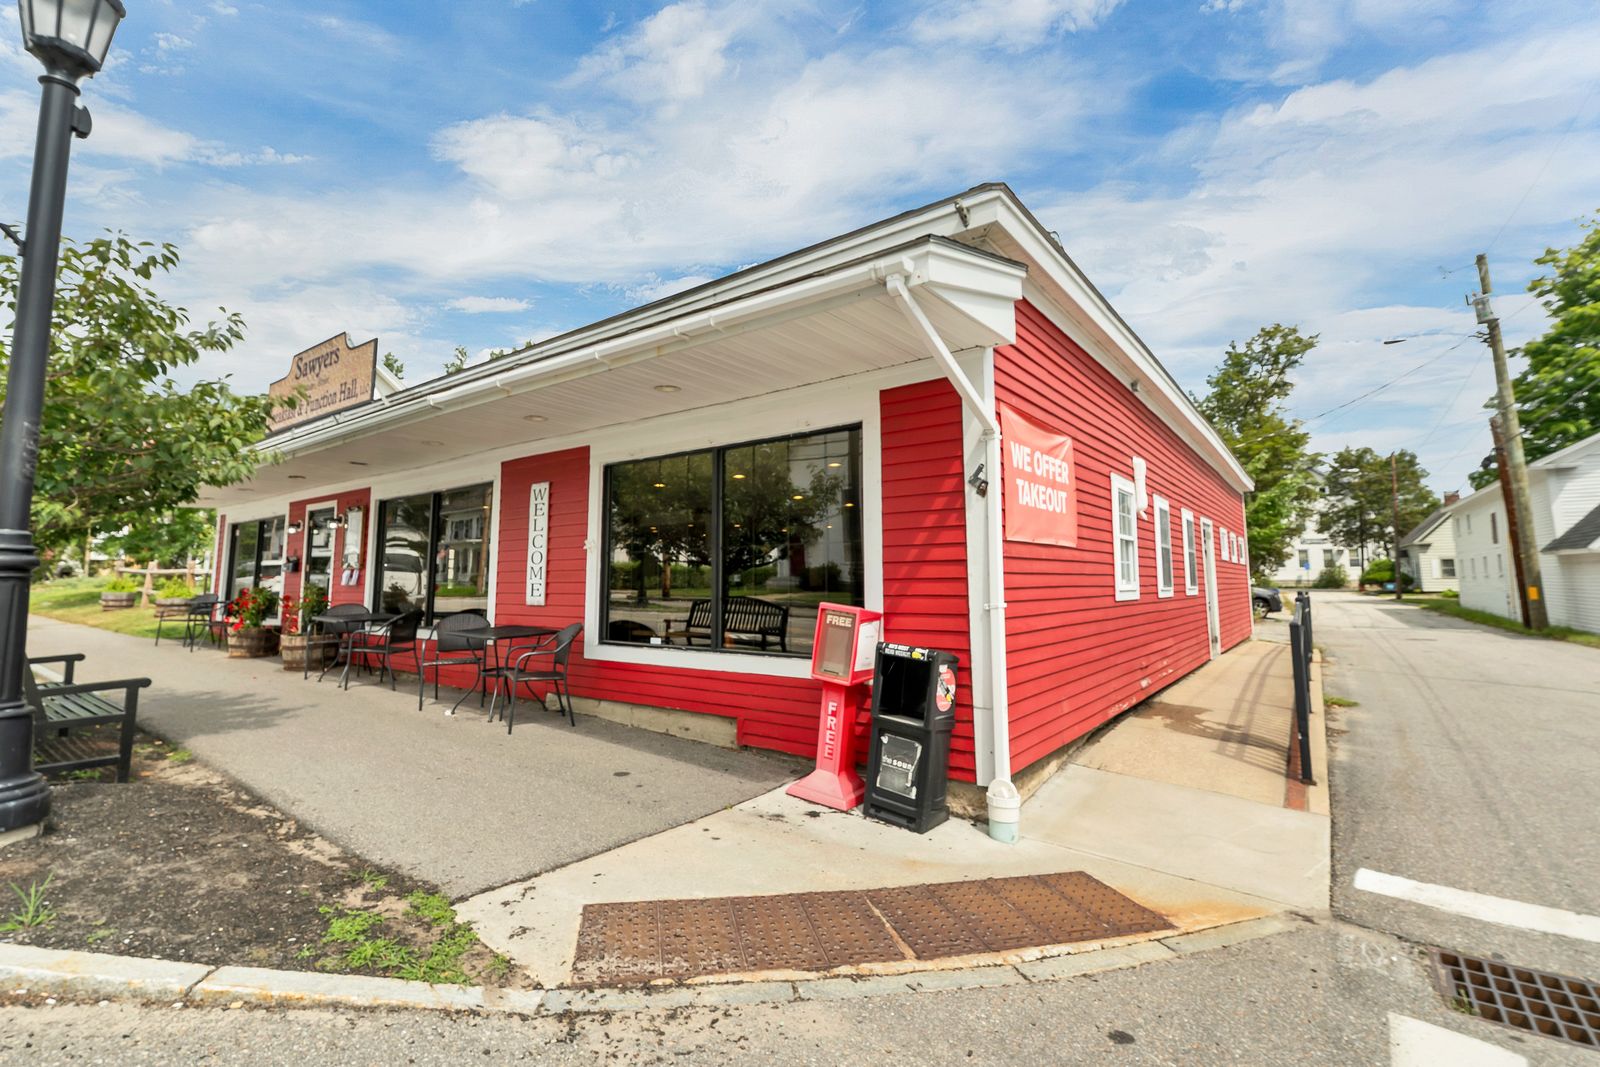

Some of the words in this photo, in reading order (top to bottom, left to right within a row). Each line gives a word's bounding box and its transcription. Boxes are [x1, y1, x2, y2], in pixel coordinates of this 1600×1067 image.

[295, 347, 340, 380] Sawyers
[1010, 441, 1032, 473] WE
[1034, 451, 1069, 485] OFFER
[1016, 478, 1067, 514] TAKEOUT
[529, 487, 547, 598] WELCOME
[826, 614, 853, 628] FREE
[824, 701, 838, 760] FREE
[892, 759, 912, 770] soun
